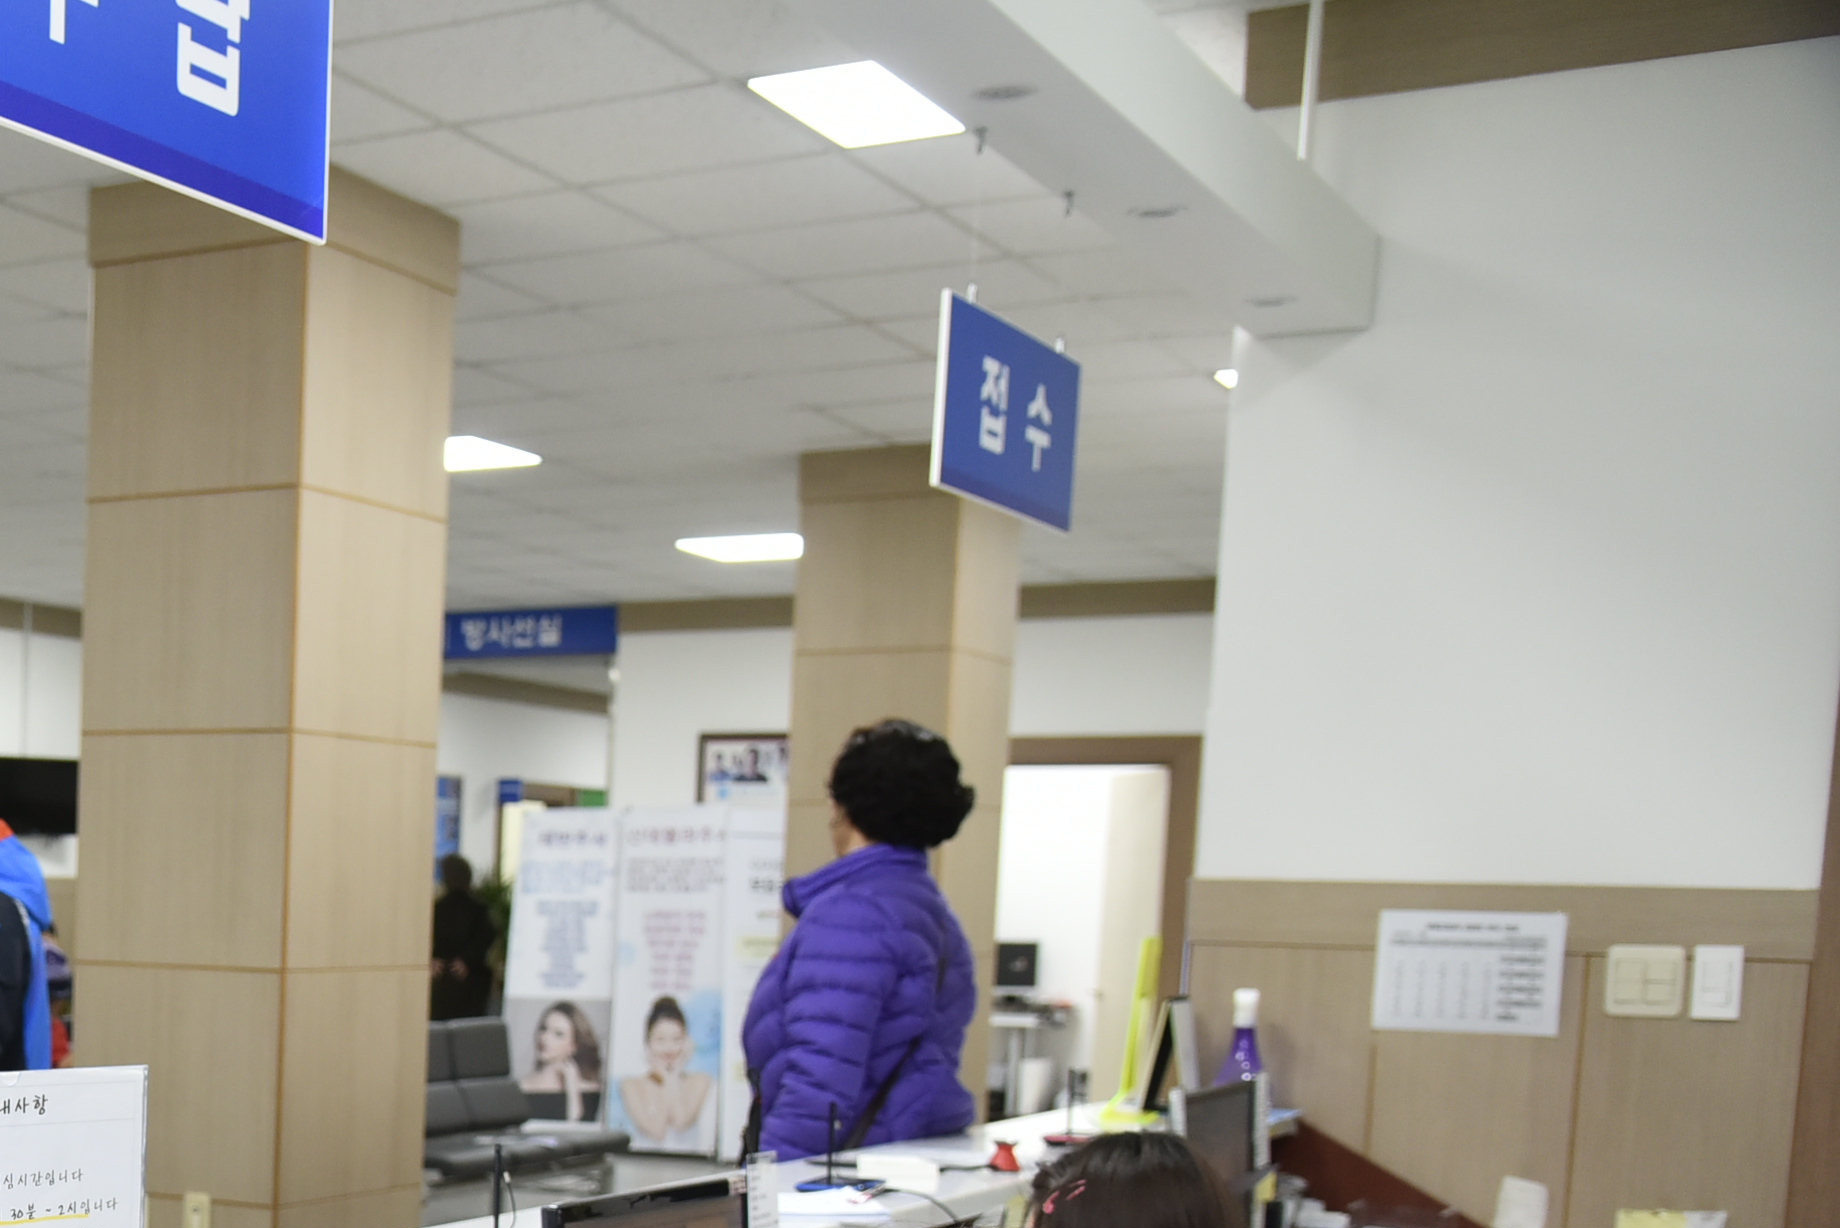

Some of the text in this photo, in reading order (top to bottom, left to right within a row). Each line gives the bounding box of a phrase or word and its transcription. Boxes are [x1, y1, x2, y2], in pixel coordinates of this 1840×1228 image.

[49, 0, 250, 116] 납
[979, 354, 1053, 472] 접수
[461, 613, 562, 651] 방사선실
[10, 1202, 37, 1221] 30분
[58, 1197, 118, 1216] 2시입니다
